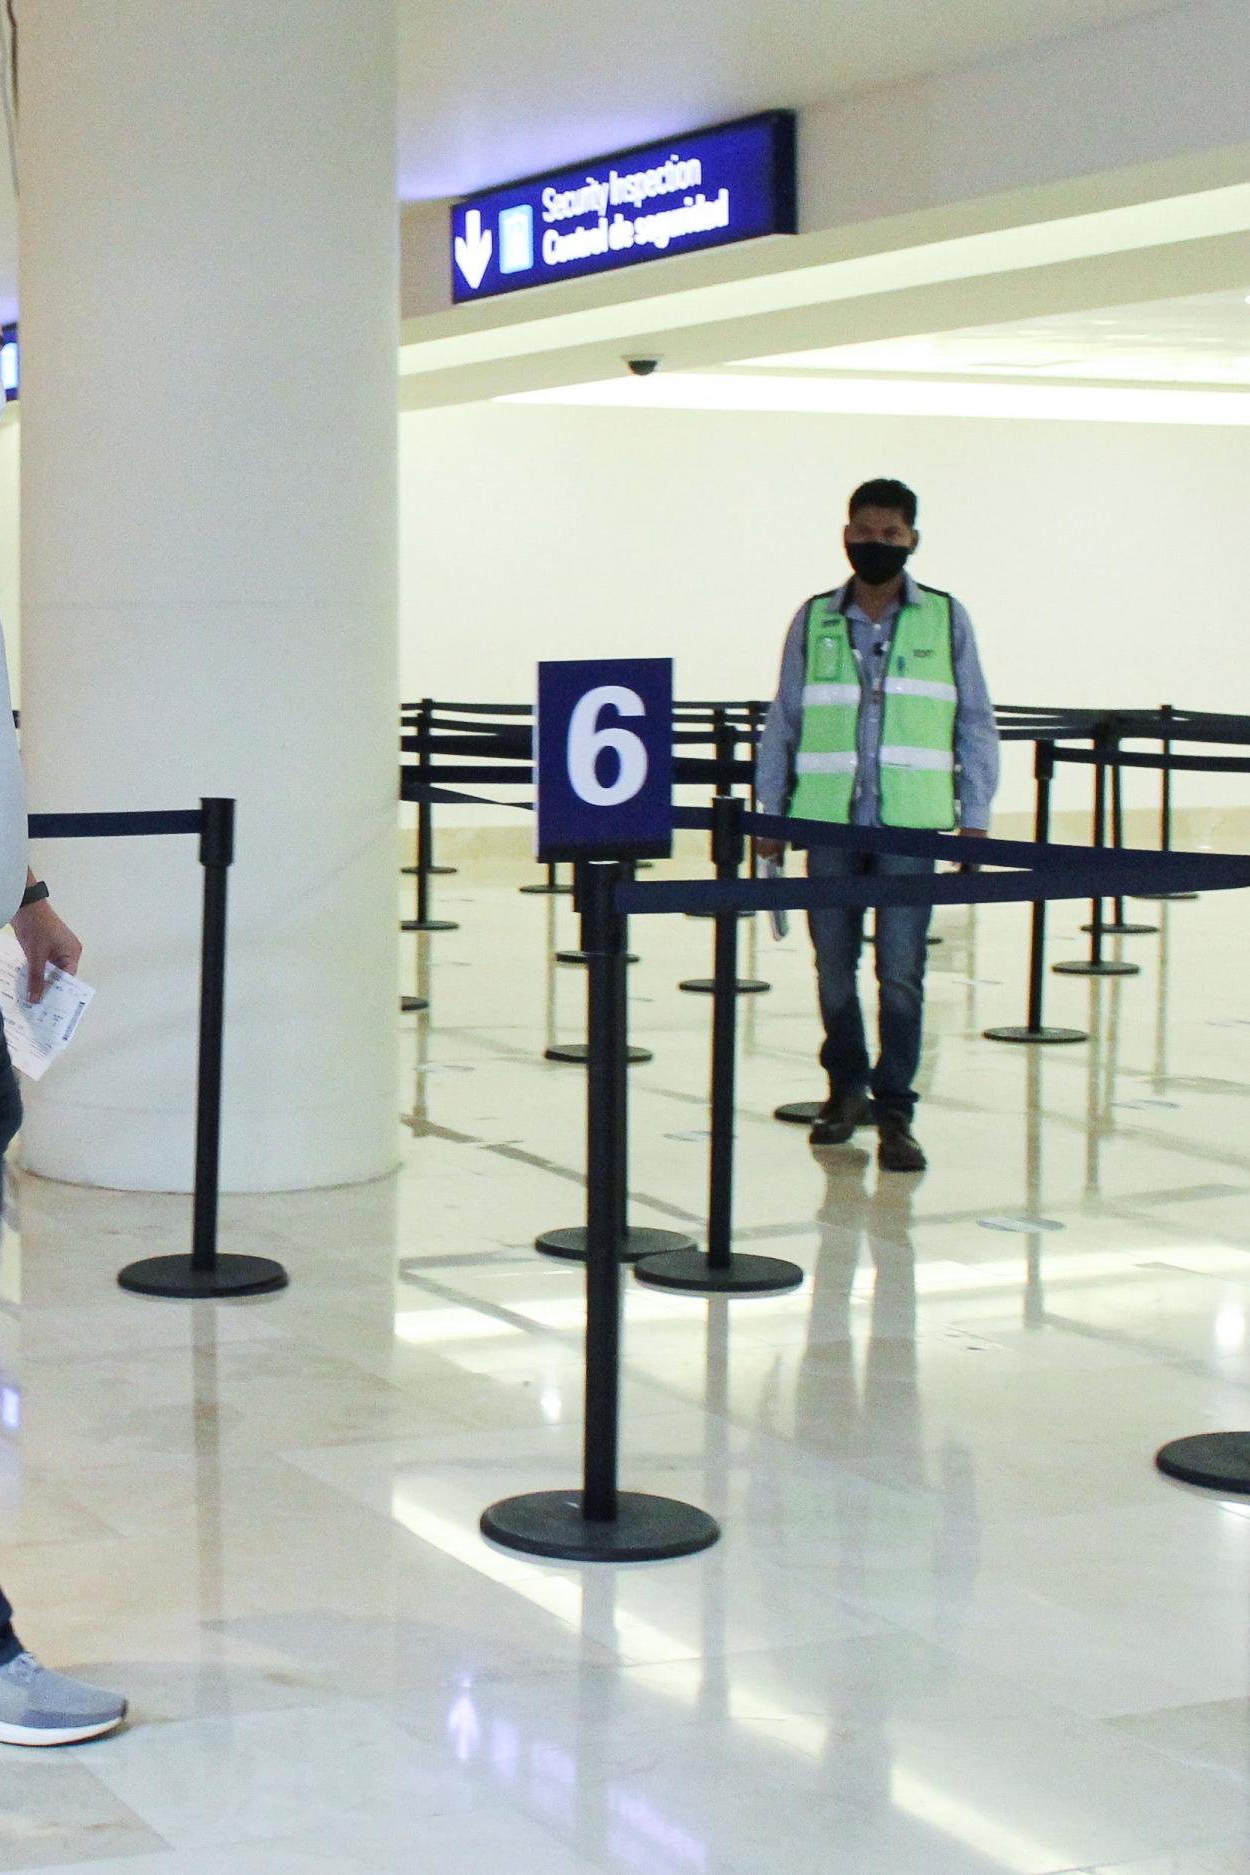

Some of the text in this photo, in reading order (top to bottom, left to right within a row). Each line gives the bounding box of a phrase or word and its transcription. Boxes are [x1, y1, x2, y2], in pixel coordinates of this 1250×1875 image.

[542, 154, 702, 222] Security Inspection
[542, 188, 729, 265] Control de seguridad
[567, 685, 648, 806] 6
